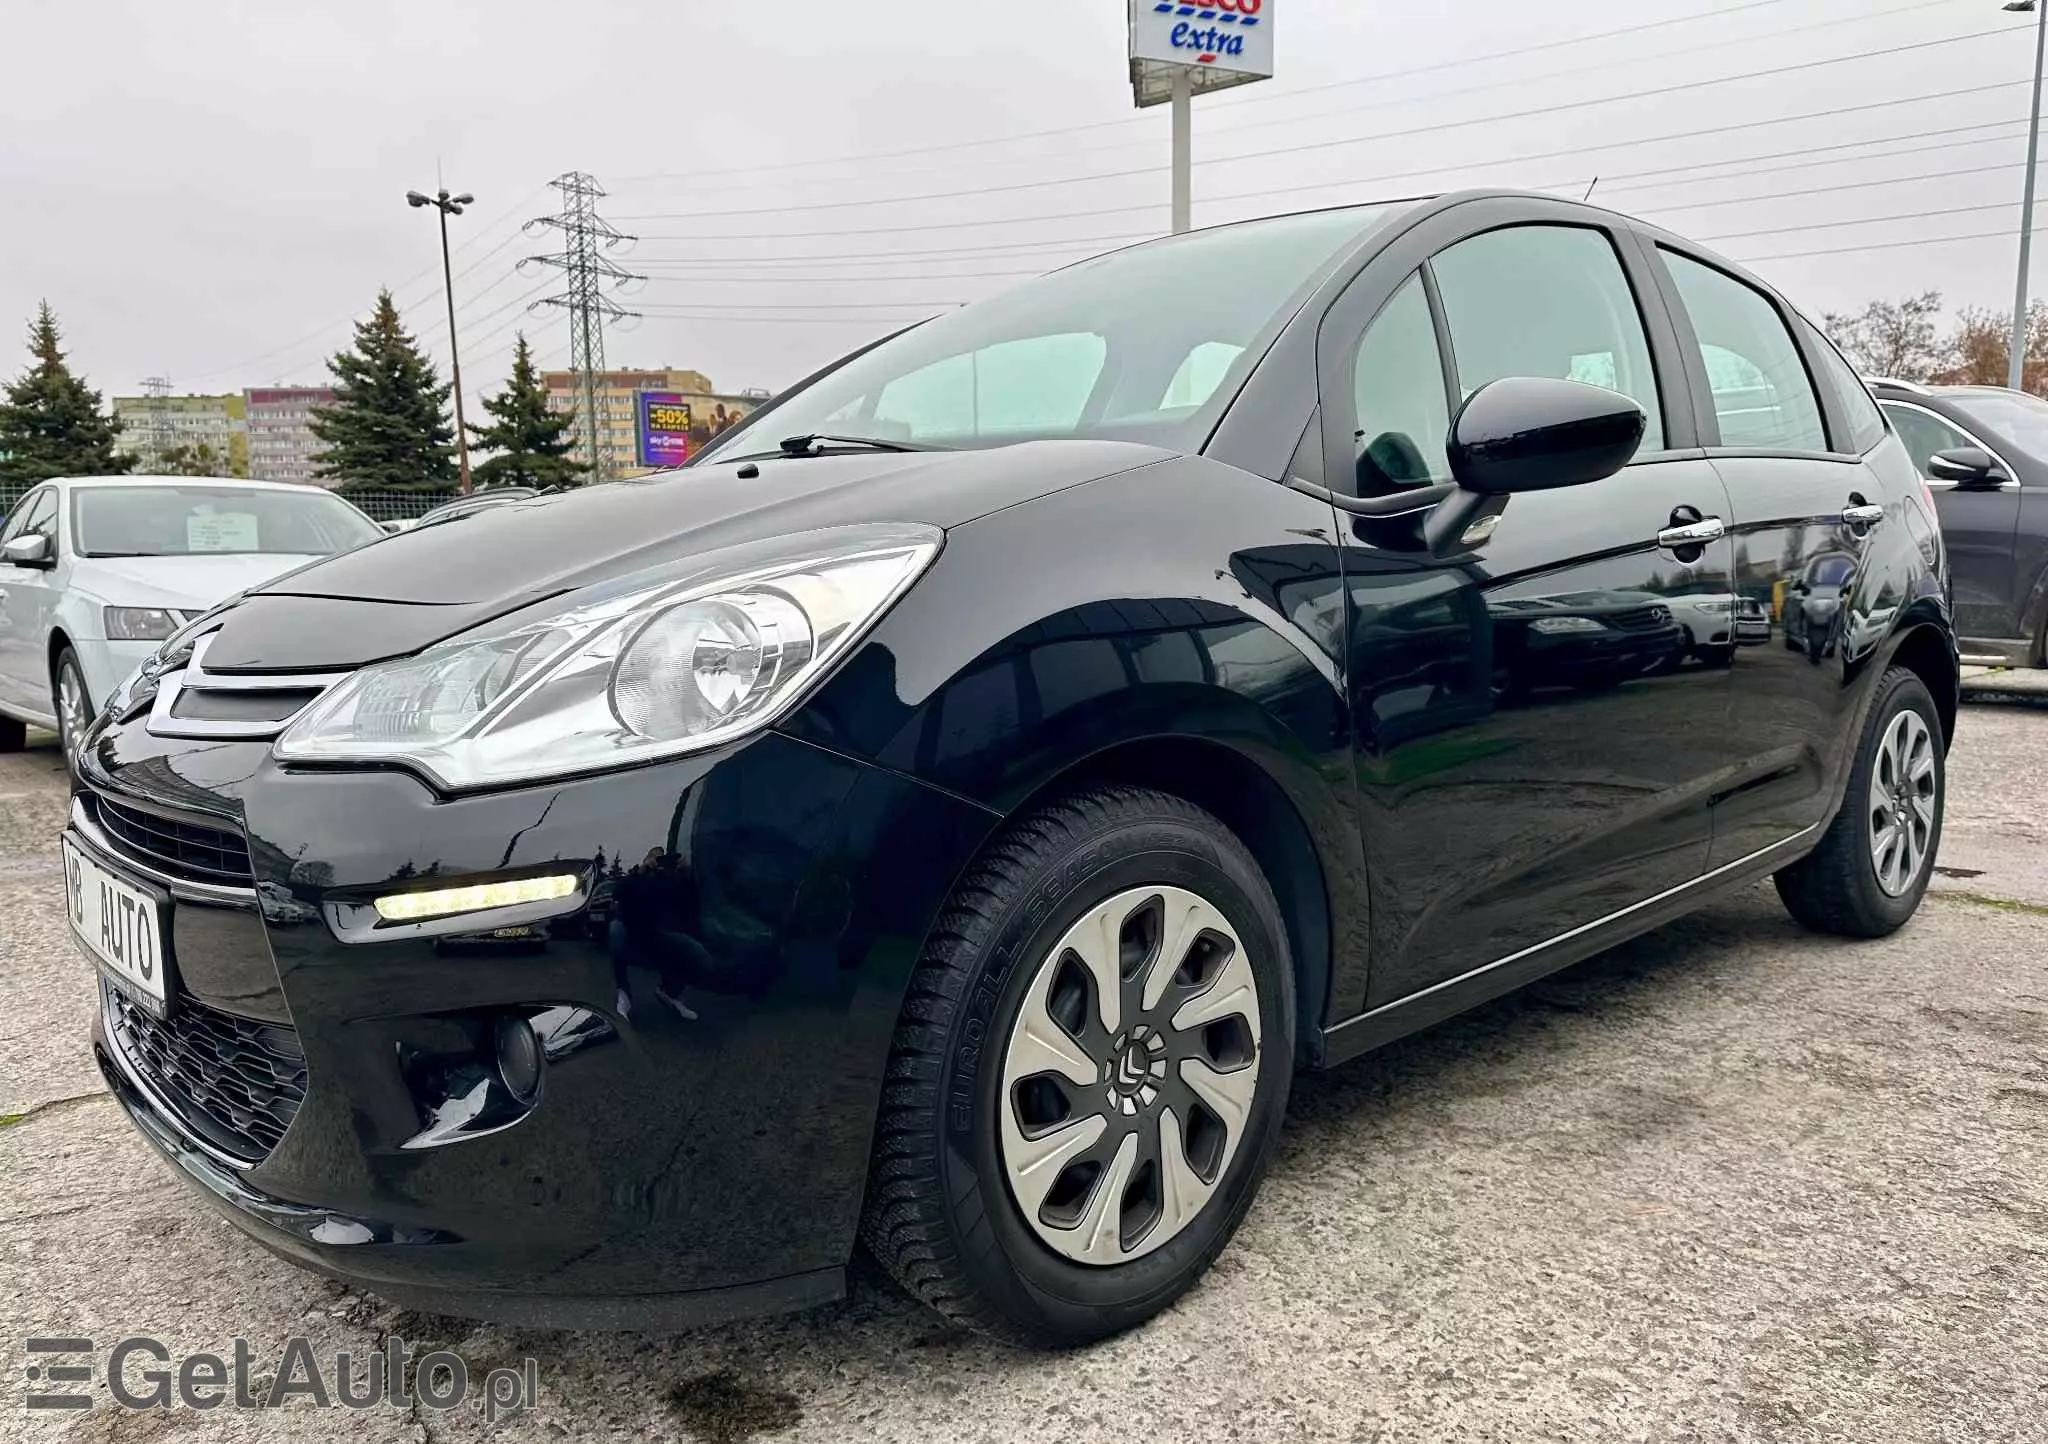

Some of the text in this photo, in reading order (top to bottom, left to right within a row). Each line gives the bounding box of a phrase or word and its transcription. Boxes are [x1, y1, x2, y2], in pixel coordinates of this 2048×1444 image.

[1171, 22, 1244, 55] extra
[650, 409, 689, 424] -50%
[101, 881, 152, 980] AUTO
